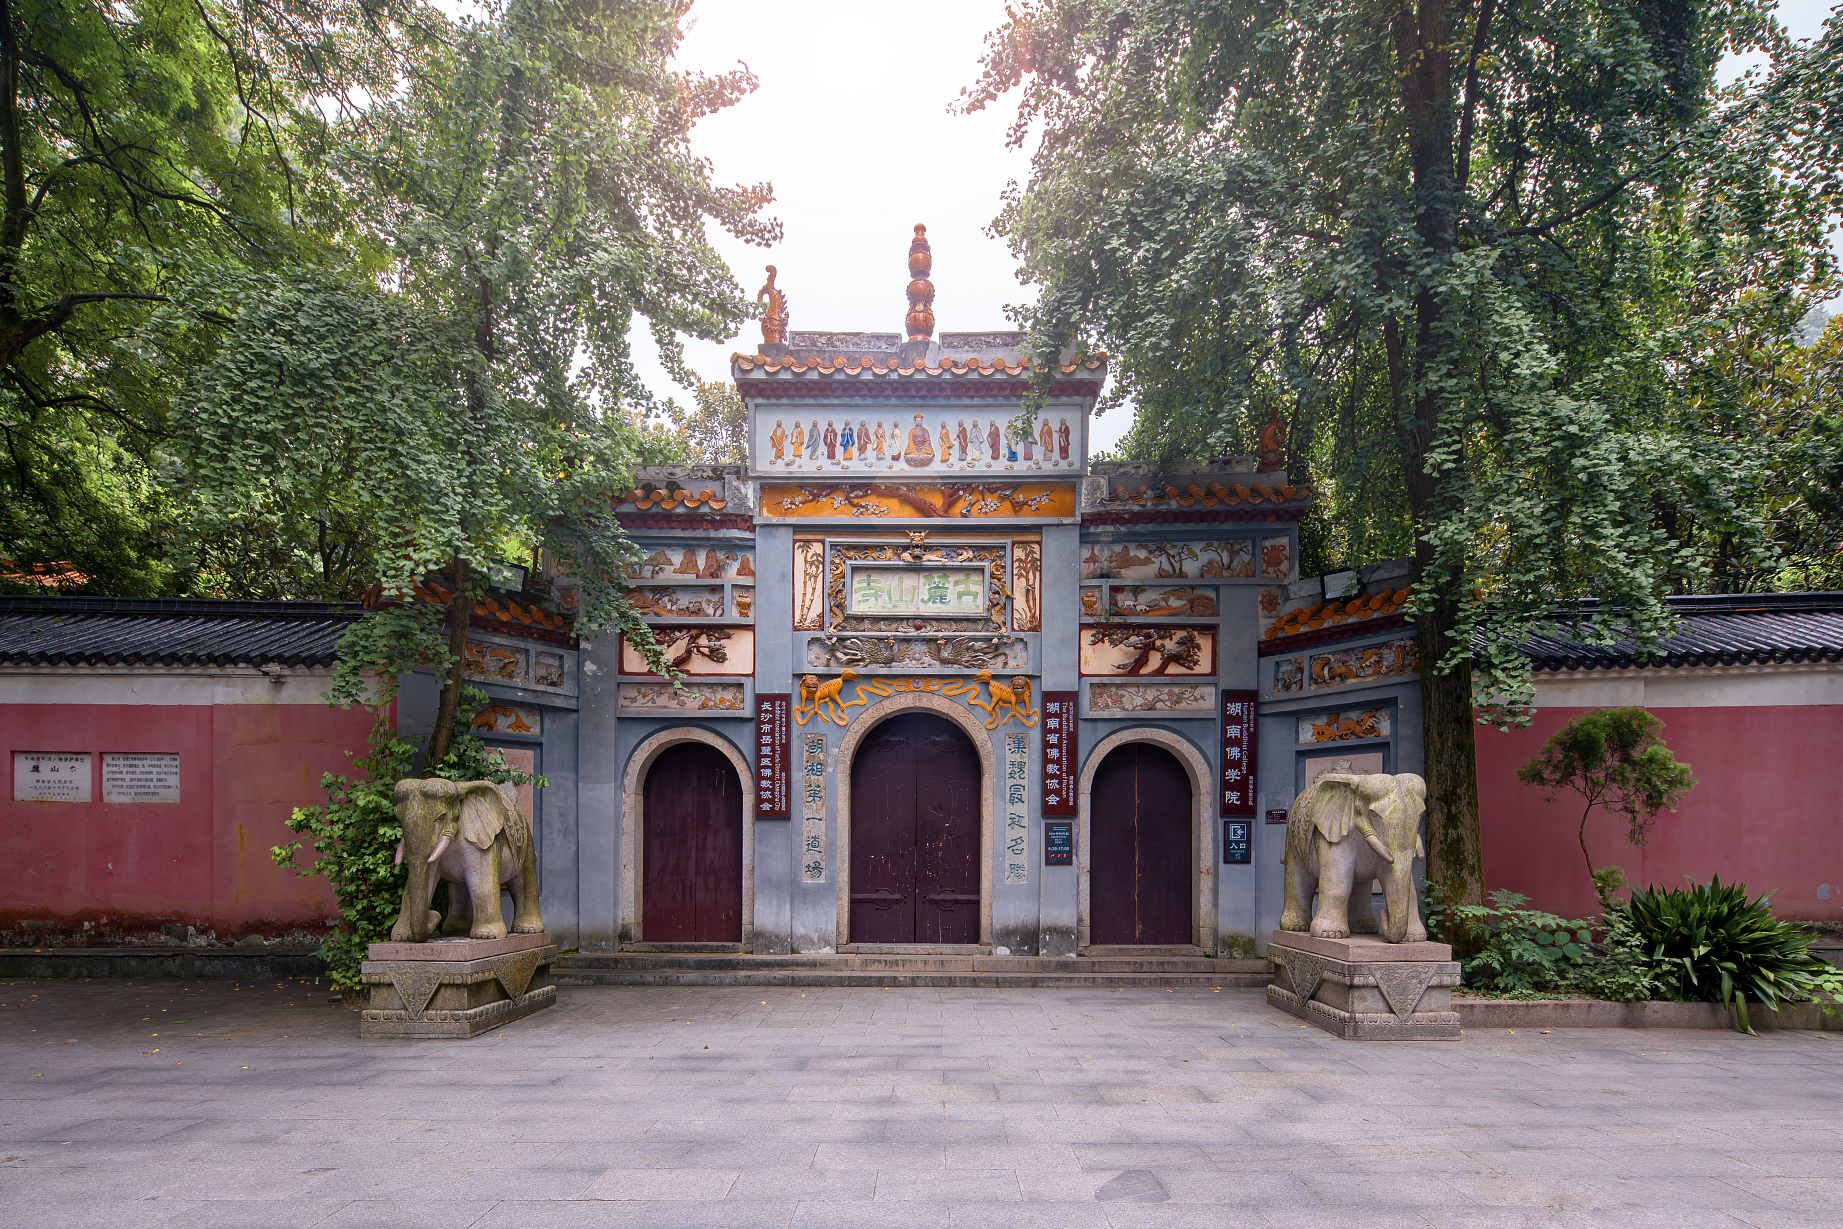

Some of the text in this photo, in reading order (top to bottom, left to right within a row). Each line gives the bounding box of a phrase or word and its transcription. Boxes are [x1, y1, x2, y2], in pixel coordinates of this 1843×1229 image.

[760, 701, 773, 811] 长沙市岳麓区佛教协会
[1046, 702, 1060, 805] 湖南省佛教协会
[1225, 702, 1242, 805] 湖南佛学院
